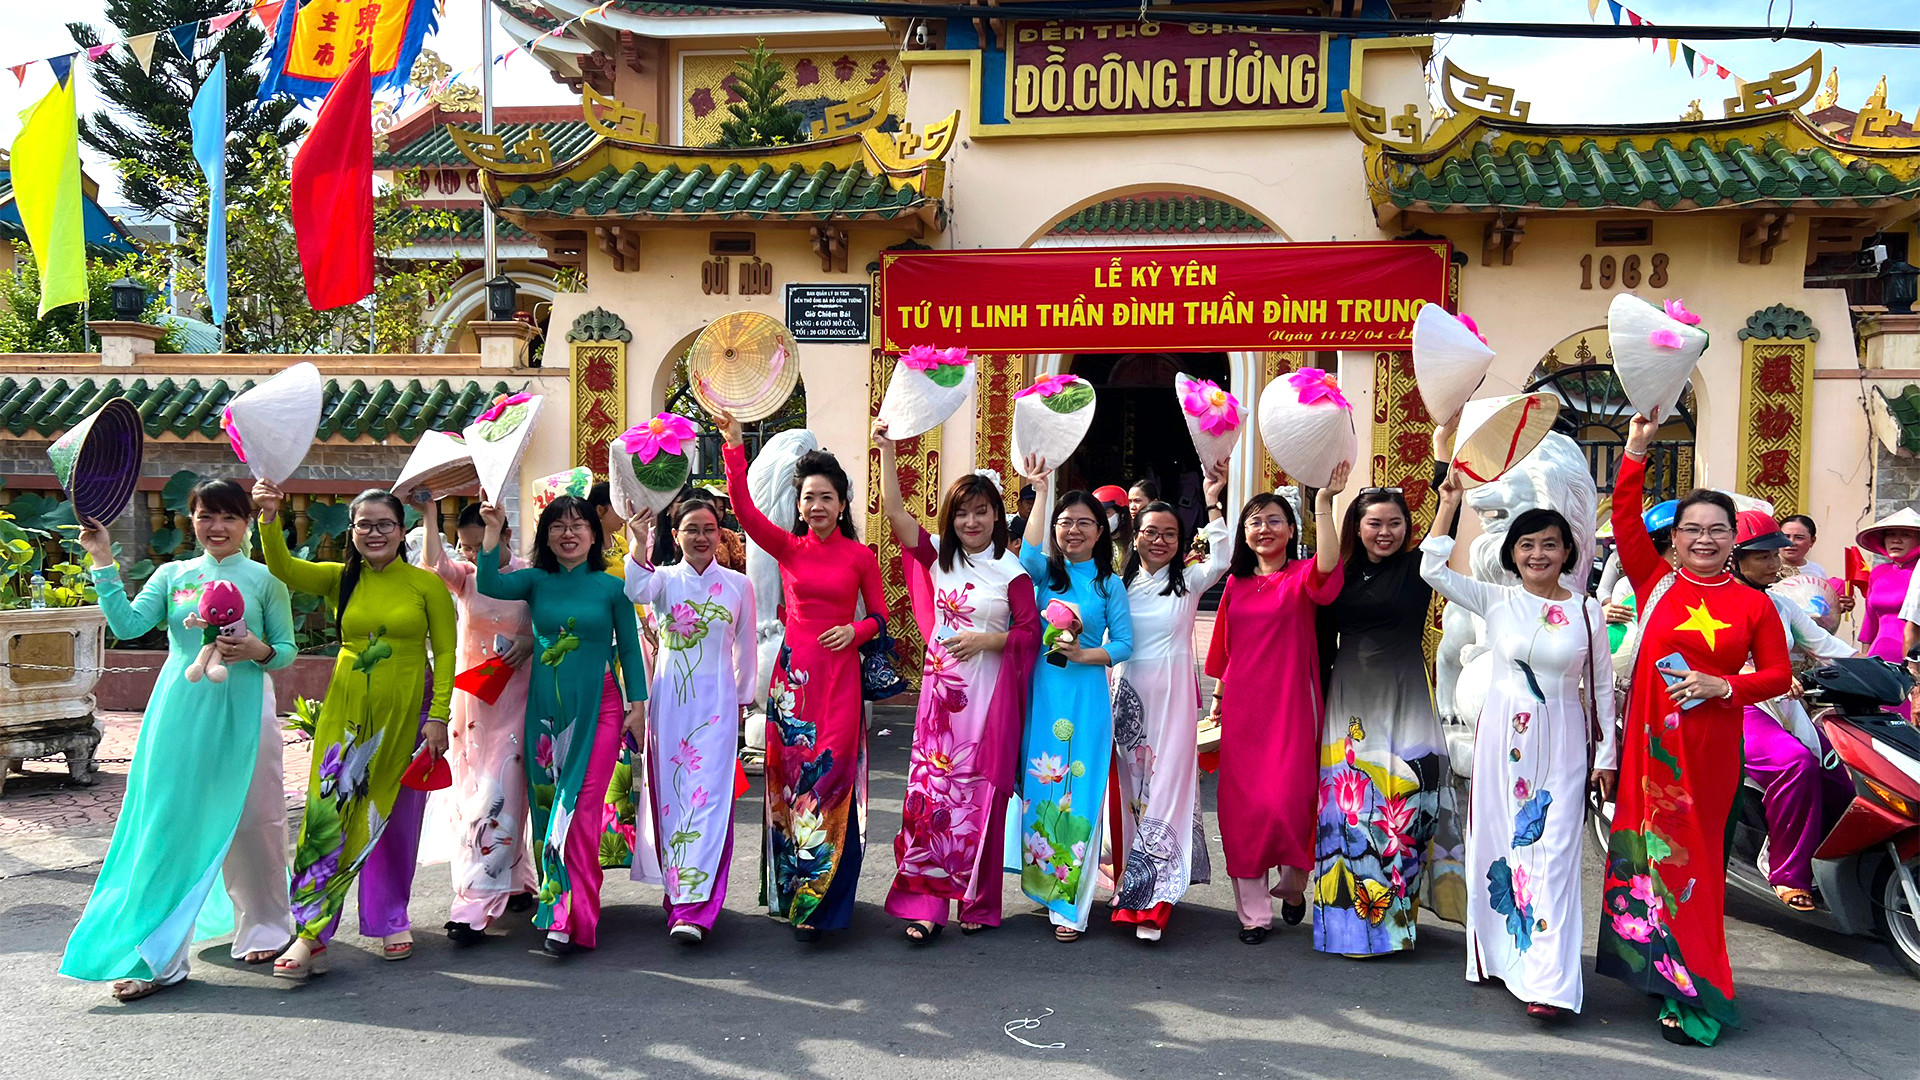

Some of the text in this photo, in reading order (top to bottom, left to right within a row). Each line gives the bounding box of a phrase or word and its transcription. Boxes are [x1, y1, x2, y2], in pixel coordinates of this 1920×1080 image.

[1094, 256, 1217, 288] LỄ KỲ YÊN
[1580, 253, 1670, 290] 1963
[897, 300, 932, 329] TỨ
[938, 305, 962, 333] VỊ
[971, 304, 1027, 328] LINH
[1036, 293, 1104, 328] THẦN
[1112, 296, 1175, 326] ĐÌNH
[1183, 290, 1254, 325] THẦN
[1262, 293, 1328, 324] ĐÌNH
[1268, 329, 1314, 343] Ngày
